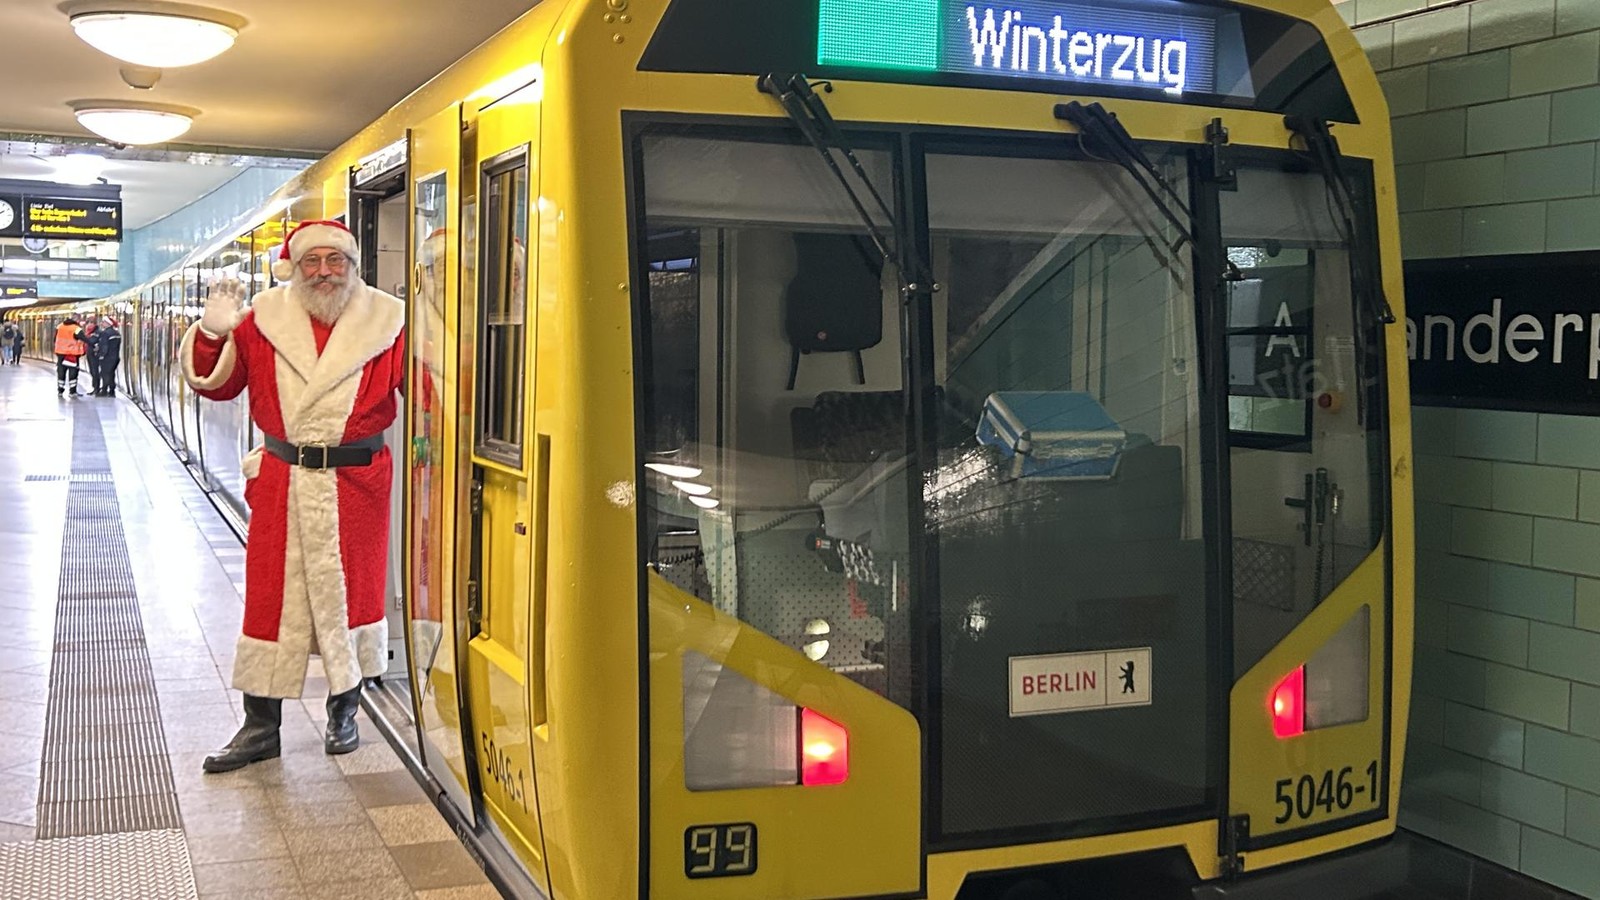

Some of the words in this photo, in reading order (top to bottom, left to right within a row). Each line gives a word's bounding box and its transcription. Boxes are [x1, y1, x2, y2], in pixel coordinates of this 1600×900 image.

[966, 6, 1187, 95] Winterzug
[1022, 671, 1096, 695] BERLIN
[482, 731, 528, 815] 5046-1
[1275, 760, 1377, 824] 5046-1
[690, 825, 751, 873] 99
